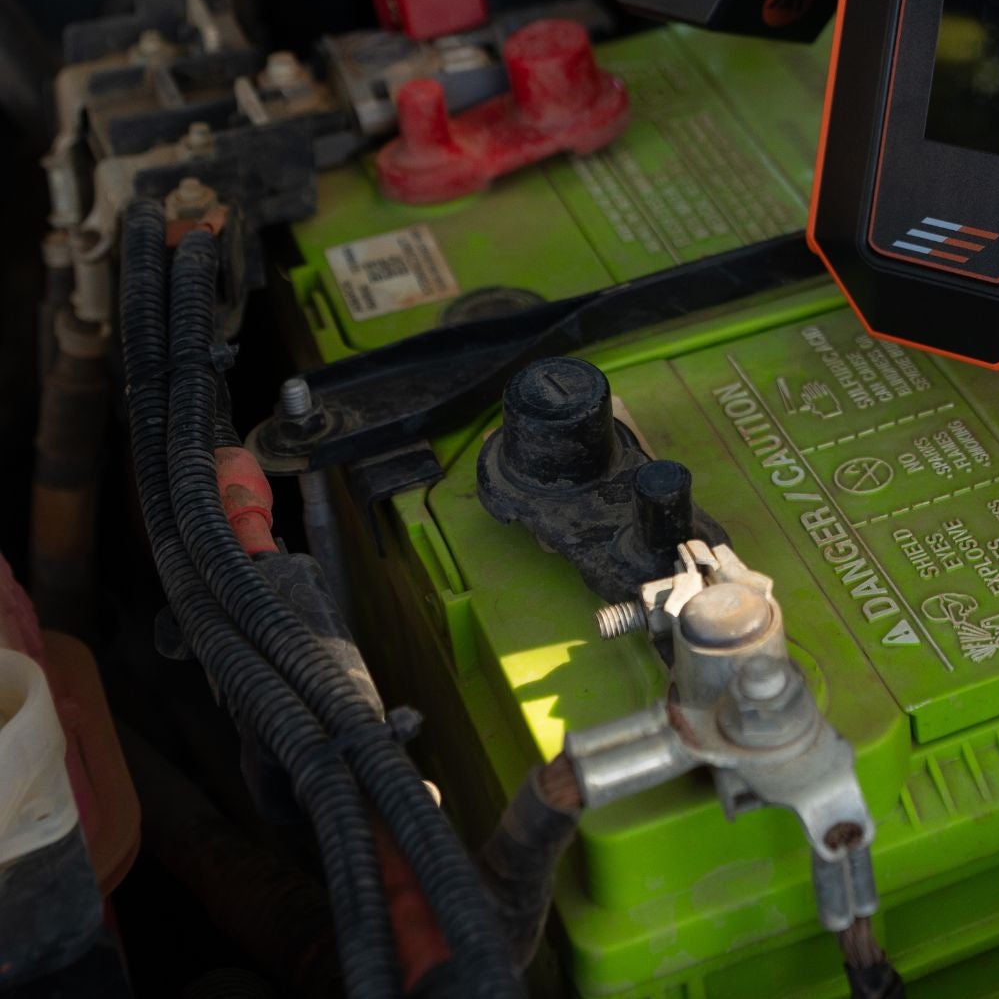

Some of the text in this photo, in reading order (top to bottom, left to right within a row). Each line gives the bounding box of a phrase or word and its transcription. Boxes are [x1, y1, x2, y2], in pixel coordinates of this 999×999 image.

[822, 350, 875, 409] SULFURIC
[869, 382, 894, 402] CAN
[712, 382, 805, 487] CAUTION
[932, 431, 971, 469] FLAMES
[898, 452, 925, 474] NO
[799, 505, 901, 623] DANGER
[893, 528, 939, 580] SHIELD
[925, 532, 964, 572] EYES
